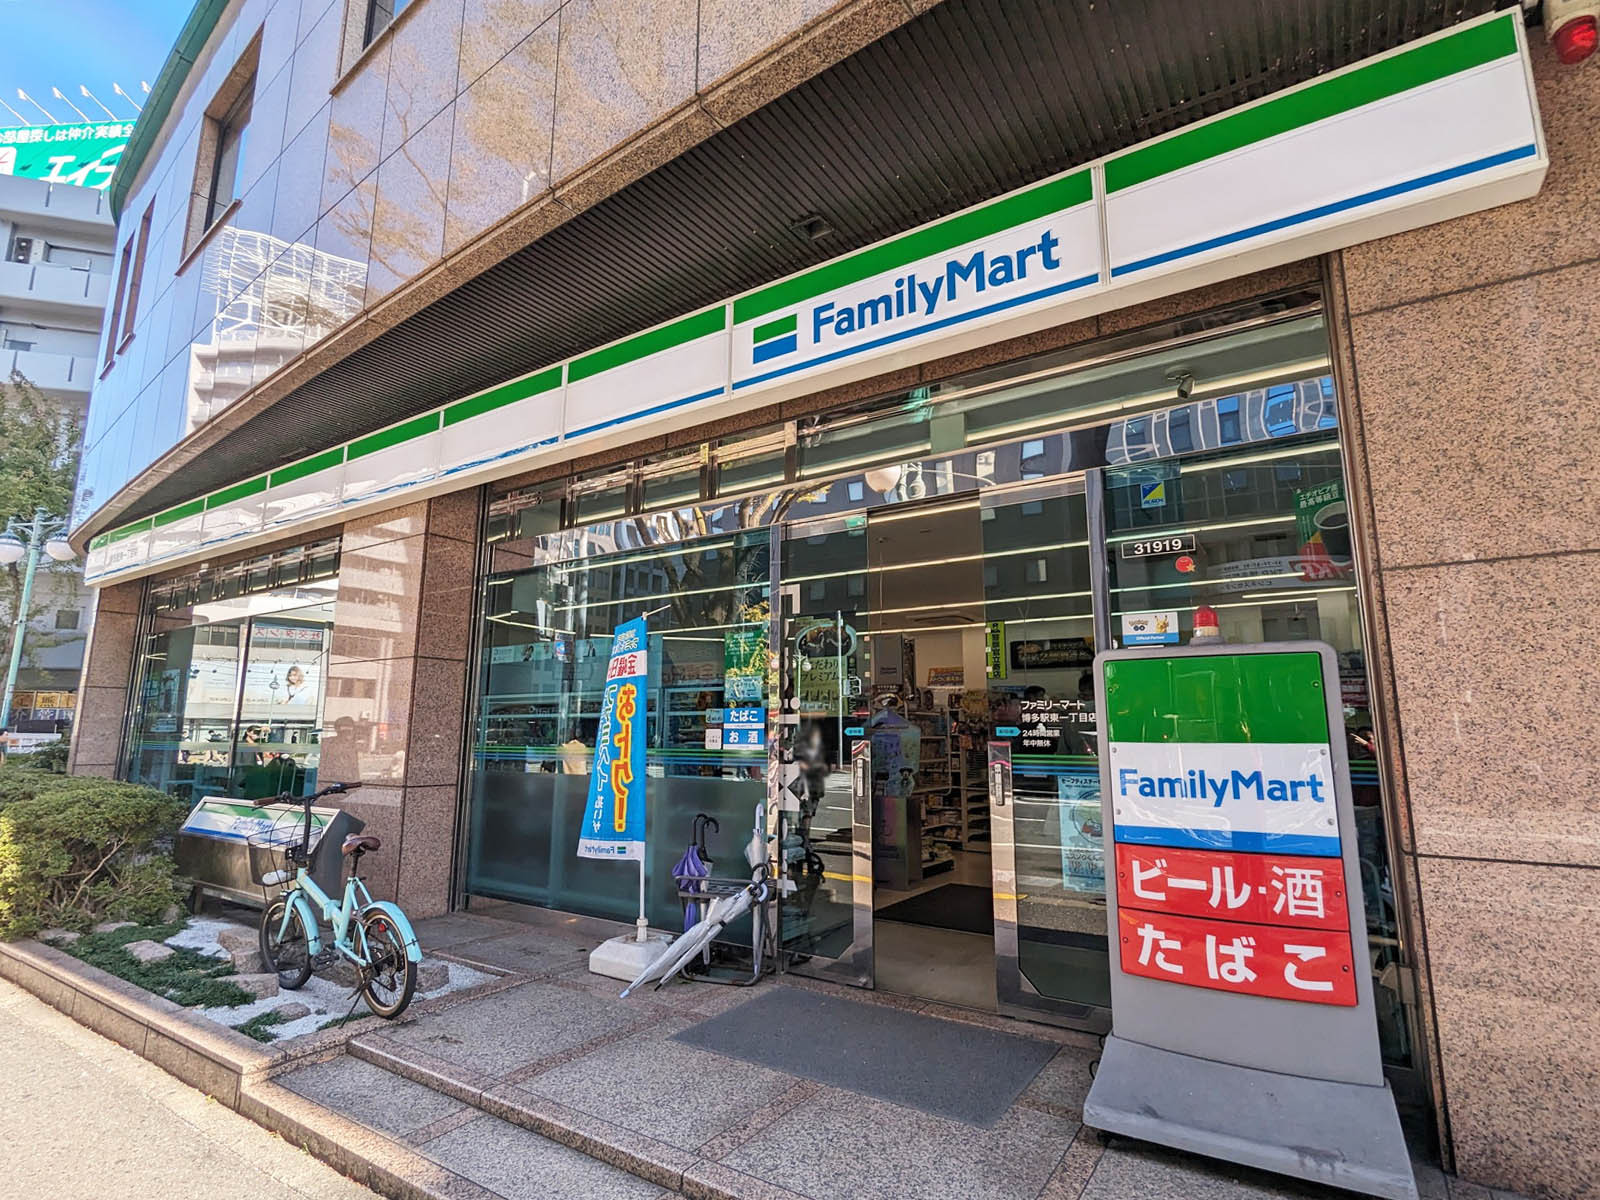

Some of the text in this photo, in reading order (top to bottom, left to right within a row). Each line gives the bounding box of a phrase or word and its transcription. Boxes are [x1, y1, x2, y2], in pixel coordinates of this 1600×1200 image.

[0, 124, 134, 144] 部屋探しは仲介実績全
[813, 229, 1061, 345] FamilyMart
[1134, 538, 1183, 555] 31919
[1020, 699, 1086, 711] ファミリーマート
[729, 709, 759, 722] たばこ
[1021, 712, 1097, 723] 博多駅東一丁目店
[1022, 739, 1052, 748] 年中無休
[1118, 768, 1325, 808] FamilyMart
[1131, 858, 1326, 919] ビール・酒
[1137, 923, 1334, 992] たばこ
